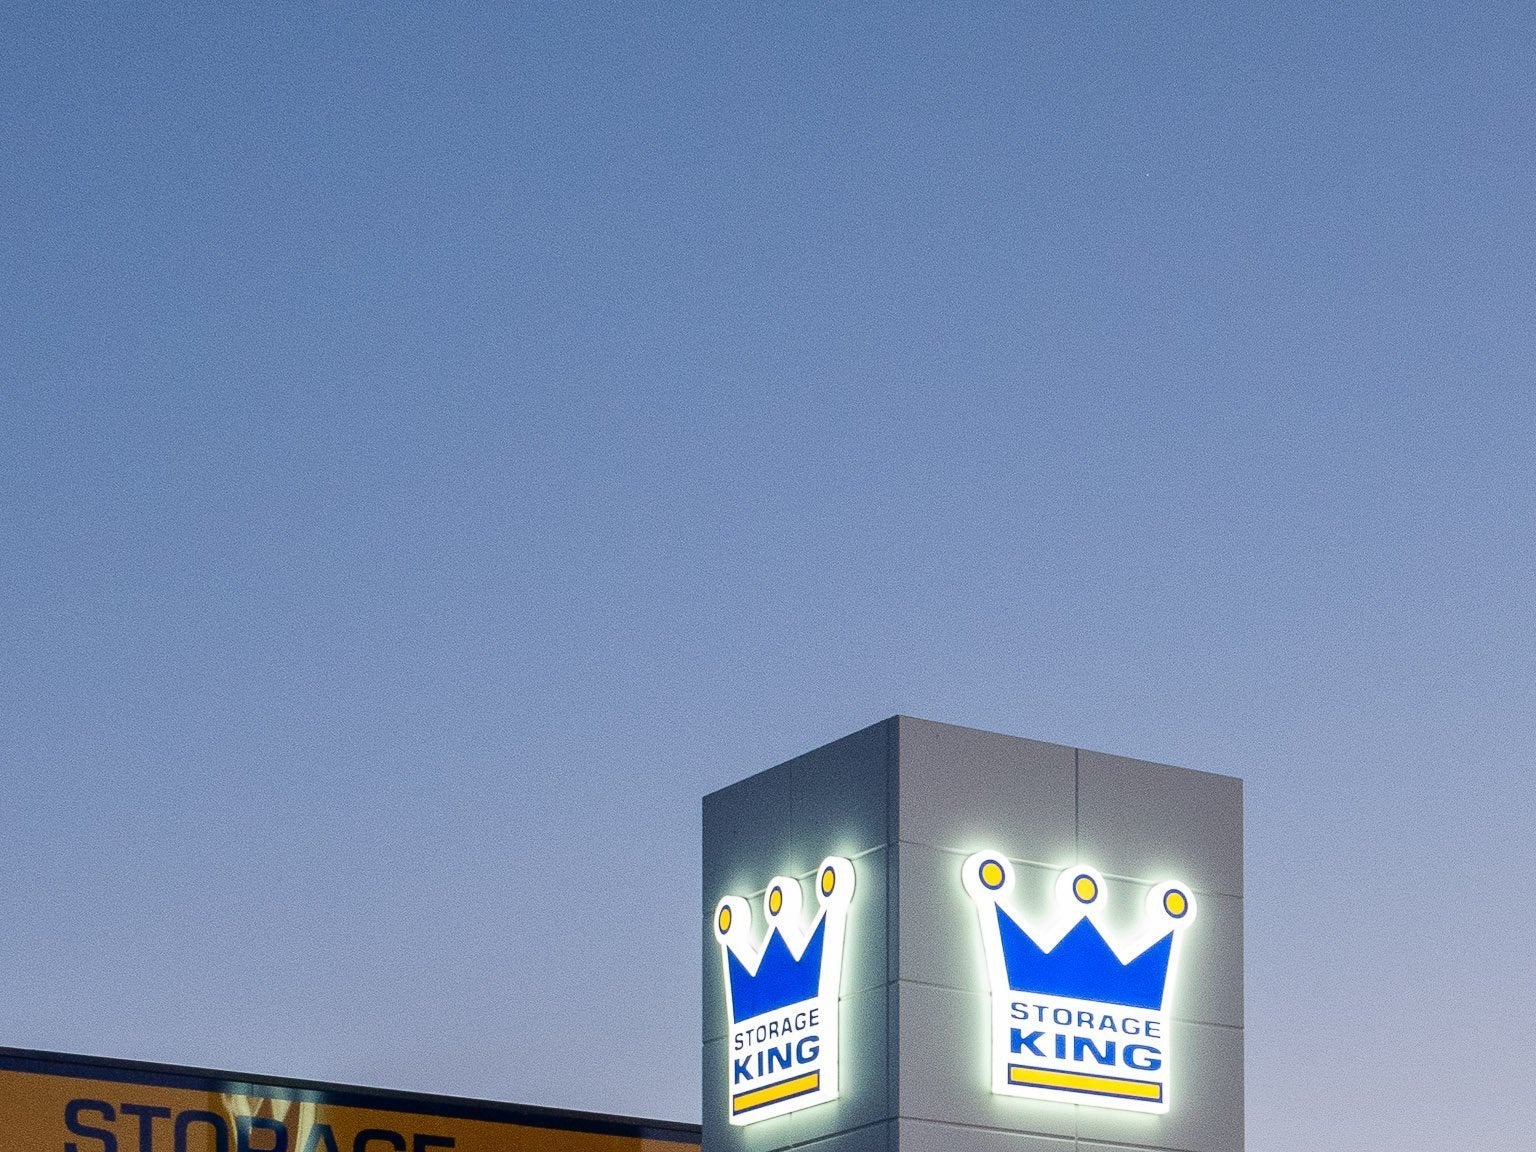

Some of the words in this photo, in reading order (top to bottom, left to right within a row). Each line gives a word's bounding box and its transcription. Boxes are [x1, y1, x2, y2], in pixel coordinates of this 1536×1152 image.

[735, 1008, 819, 1051] STORAGE
[1010, 1002, 1161, 1039] STORAGE
[734, 1035, 820, 1084] KING
[1010, 1027, 1162, 1071] KING
